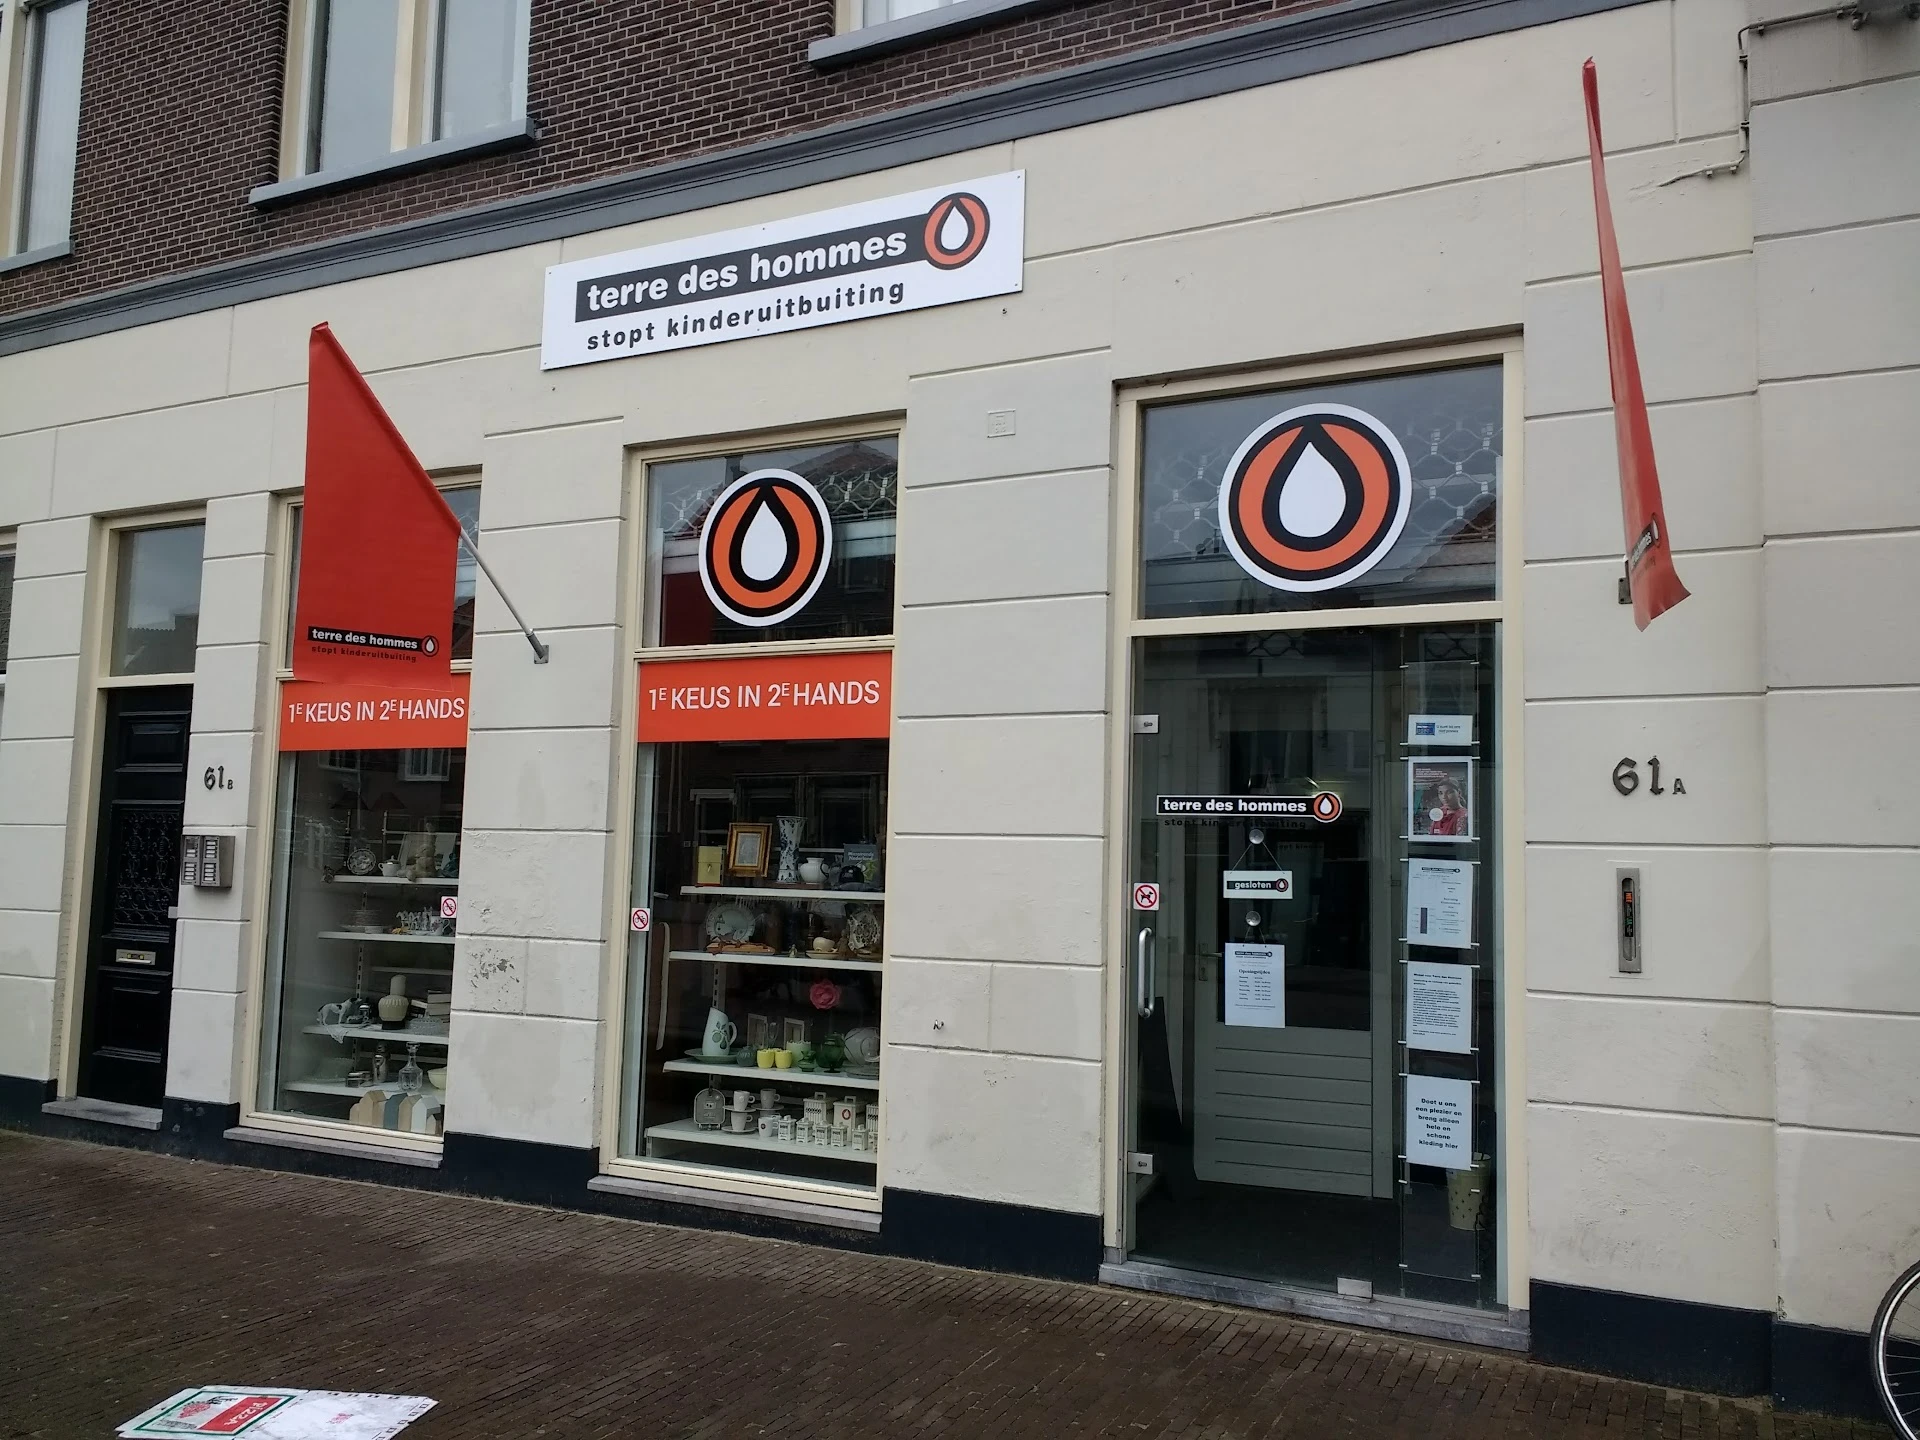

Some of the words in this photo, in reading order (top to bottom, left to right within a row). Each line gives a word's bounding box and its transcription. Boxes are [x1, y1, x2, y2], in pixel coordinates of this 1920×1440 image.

[587, 278, 667, 311] terre
[677, 261, 739, 296] des
[750, 229, 907, 284] hommes
[587, 323, 655, 351] stopt
[667, 281, 905, 338] kinderuitbuiting
[312, 628, 343, 642] terre
[345, 632, 366, 644] des
[369, 634, 418, 649] hommes
[311, 645, 337, 656] stopt
[340, 646, 417, 663] kinderuitbuiting
[671, 686, 730, 710] KEUS
[737, 685, 761, 708] IN
[793, 680, 880, 706] HANDS
[305, 701, 351, 723] KEUS
[356, 700, 375, 721] IN
[399, 697, 465, 720] HANDS
[1163, 799, 1202, 811] terre
[1206, 798, 1234, 811] des
[1238, 799, 1307, 812] hommes
[1234, 880, 1272, 890] gesloten
[1418, 1114, 1437, 1122] breng
[1418, 1139, 1443, 1148] kleding
